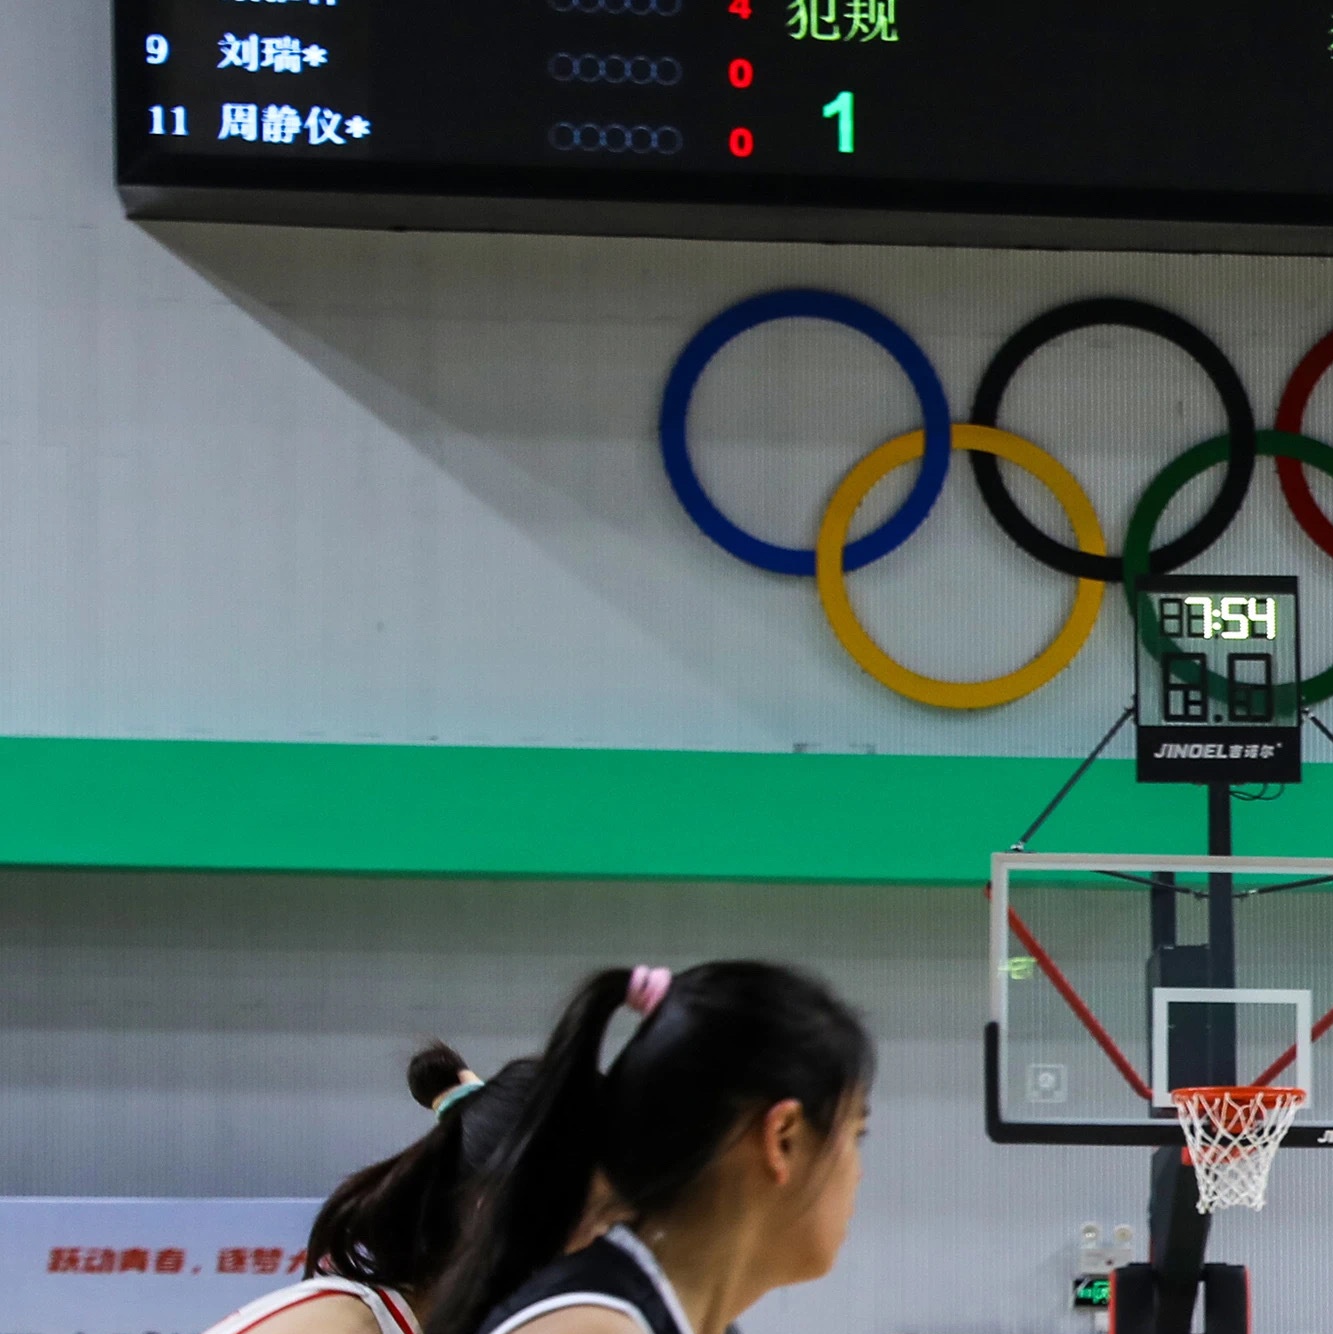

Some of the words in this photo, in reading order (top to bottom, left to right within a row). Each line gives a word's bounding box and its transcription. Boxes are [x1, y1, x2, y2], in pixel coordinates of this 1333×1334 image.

[786, 0, 899, 42] 犯规
[145, 34, 170, 64] 9
[729, 58, 754, 88] 0
[148, 105, 190, 136] 11
[729, 127, 754, 157] 0
[823, 91, 854, 153] 1
[1184, 596, 1276, 640] 7:54
